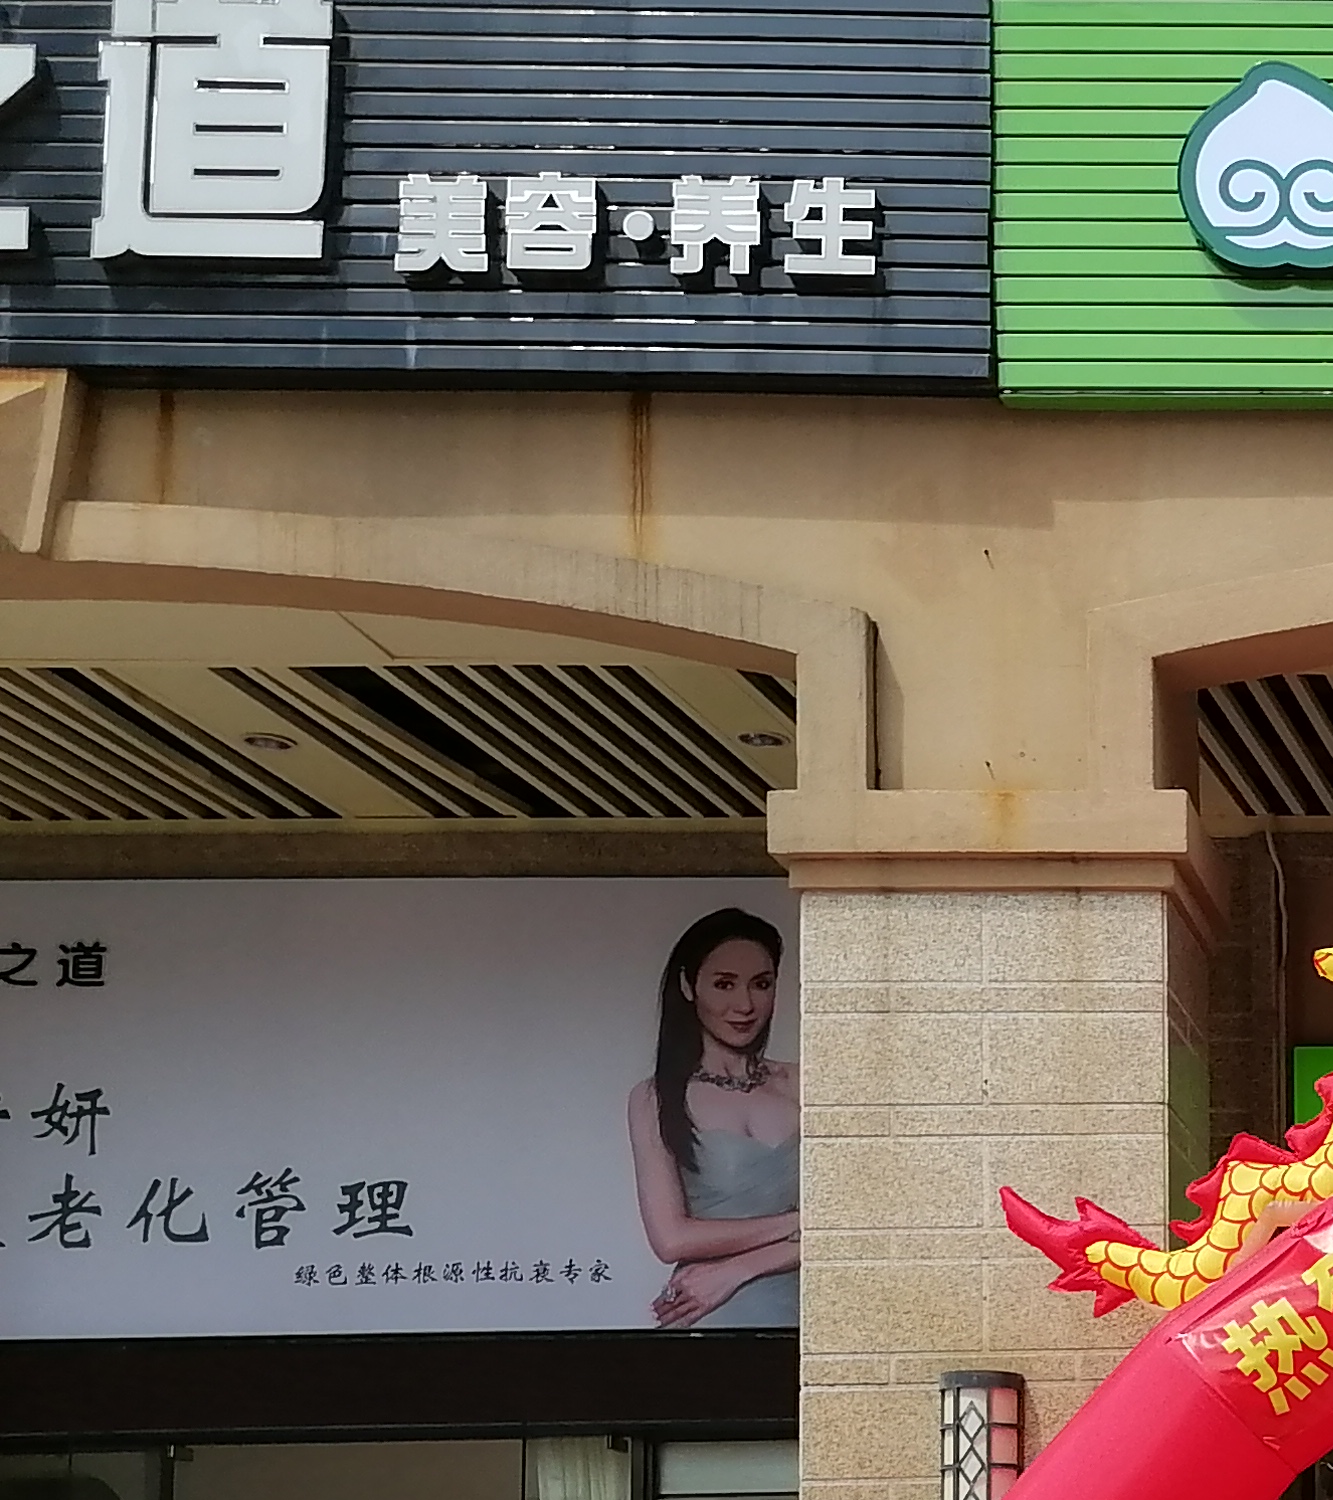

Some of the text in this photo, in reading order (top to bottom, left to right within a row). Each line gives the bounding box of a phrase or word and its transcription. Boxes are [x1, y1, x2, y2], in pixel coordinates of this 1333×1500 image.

[0, 0, 334, 262] 道
[0, 1083, 111, 1156] 妍
[0, 1167, 415, 1250] 老化管理
[294, 1258, 614, 1288] 绿色整体根源性抗衰专家
